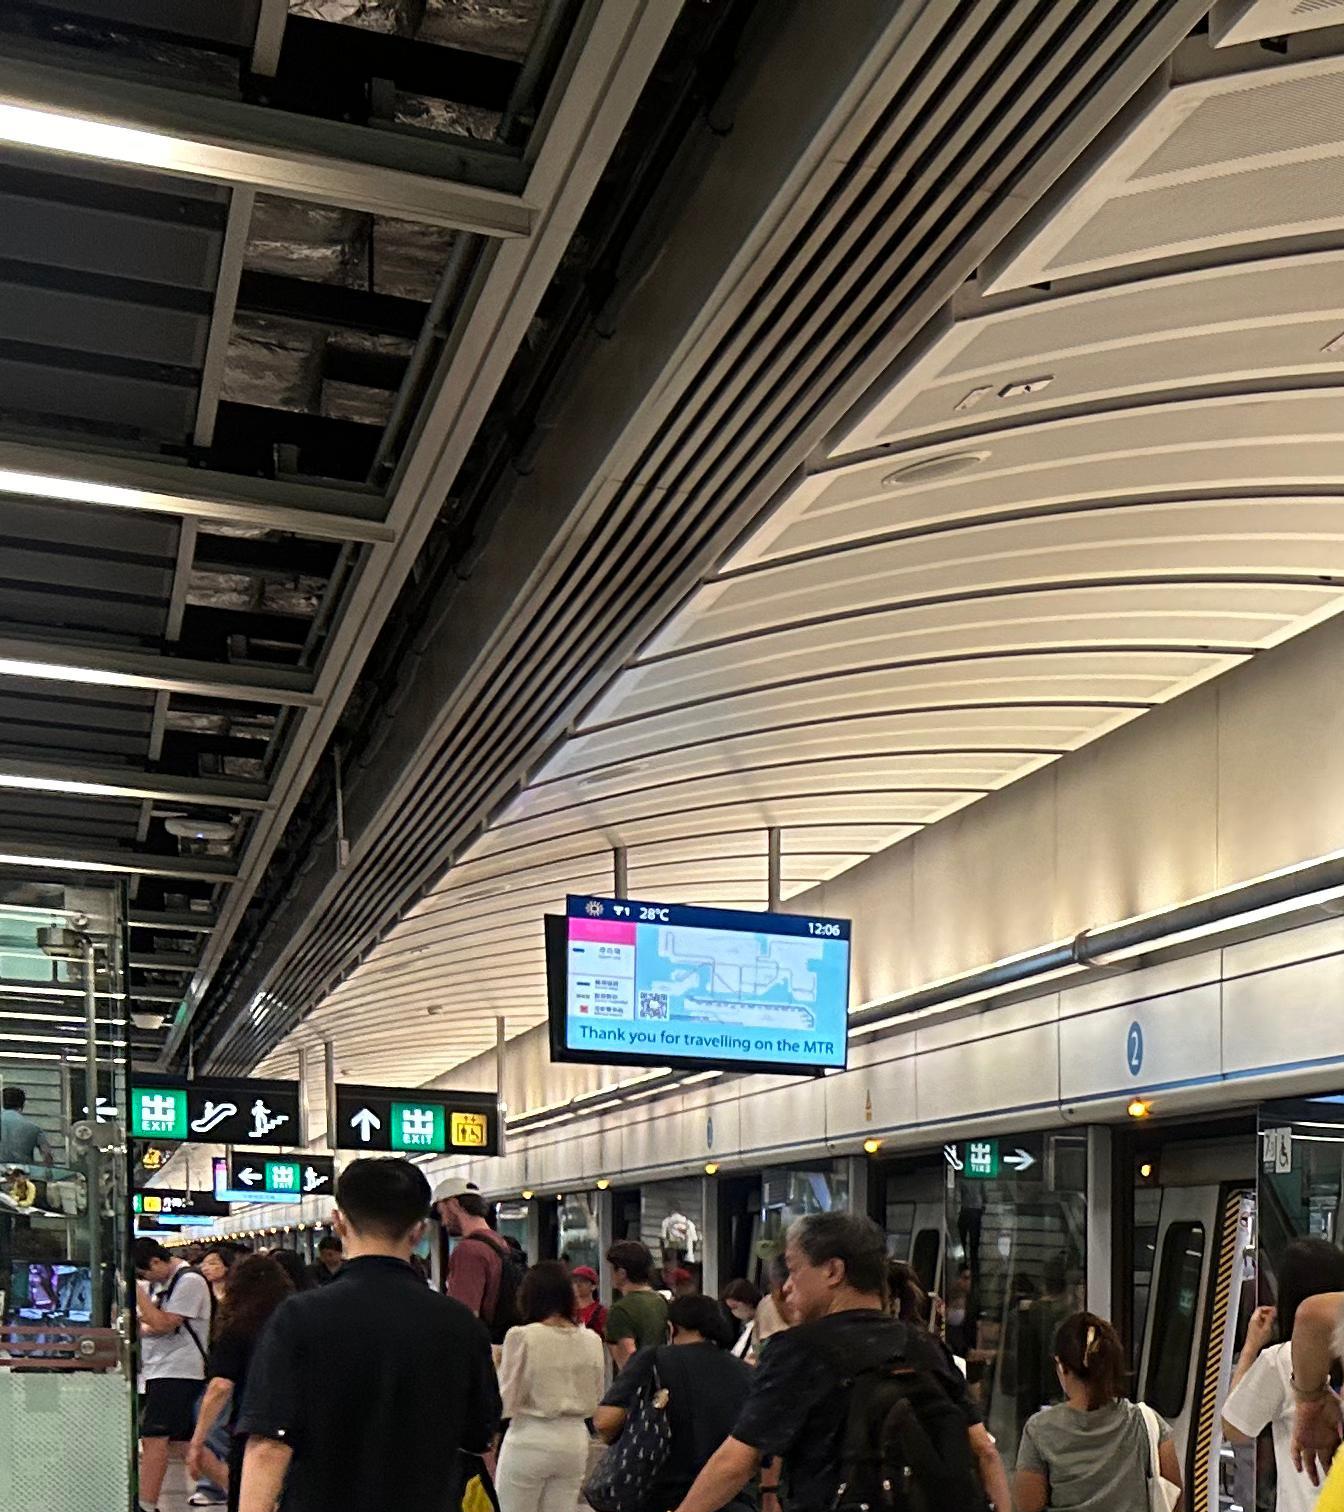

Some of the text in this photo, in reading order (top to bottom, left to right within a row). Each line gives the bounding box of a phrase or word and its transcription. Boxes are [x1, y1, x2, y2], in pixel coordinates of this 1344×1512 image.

[808, 922, 840, 936] 12:06
[579, 1025, 834, 1055] Thank you for travelling on the MTR
[1131, 1031, 1139, 1066] 2
[142, 1120, 175, 1131] EXIT
[402, 1133, 433, 1144] EXIT
